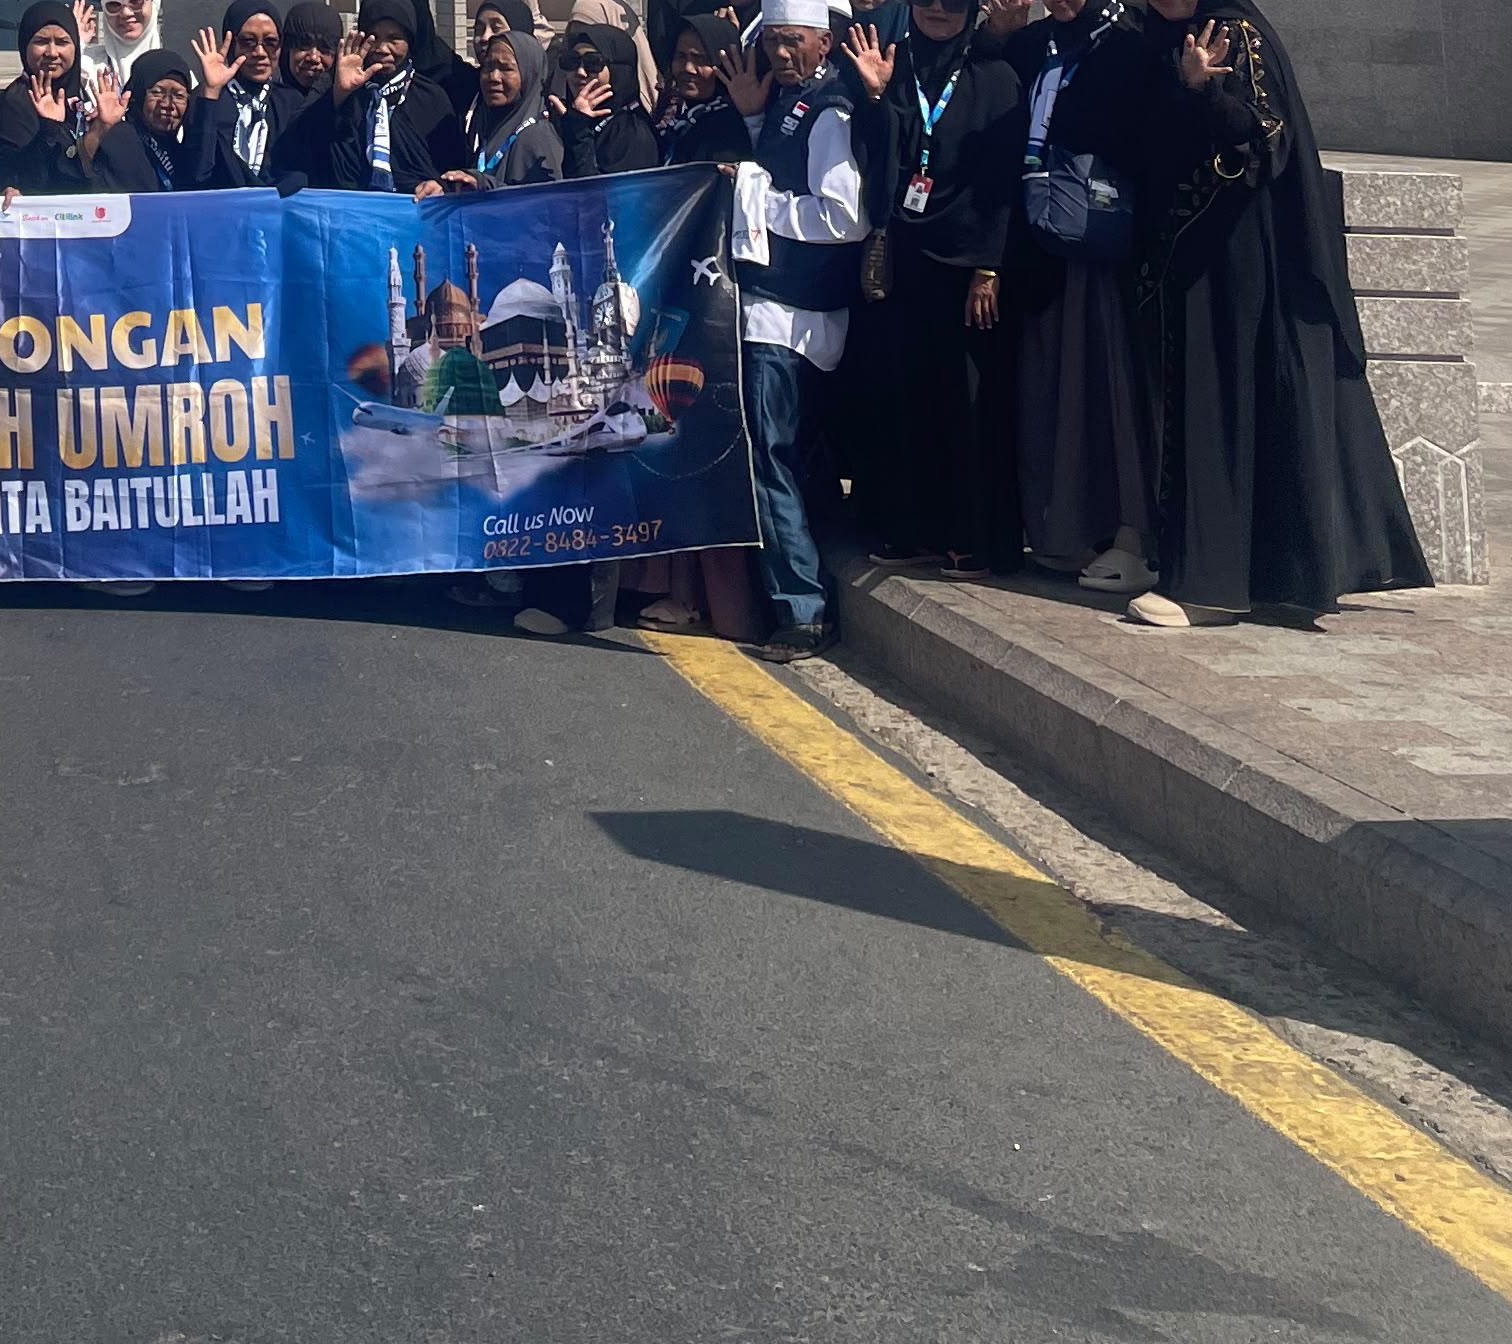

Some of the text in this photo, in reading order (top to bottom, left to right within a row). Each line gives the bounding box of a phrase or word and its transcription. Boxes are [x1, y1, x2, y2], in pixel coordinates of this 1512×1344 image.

[56, 375, 295, 469] UMROH
[64, 469, 280, 532] BAITULLAH
[483, 513, 520, 536] Call
[524, 514, 545, 529] us
[483, 519, 663, 560] 0822-8484-3497
